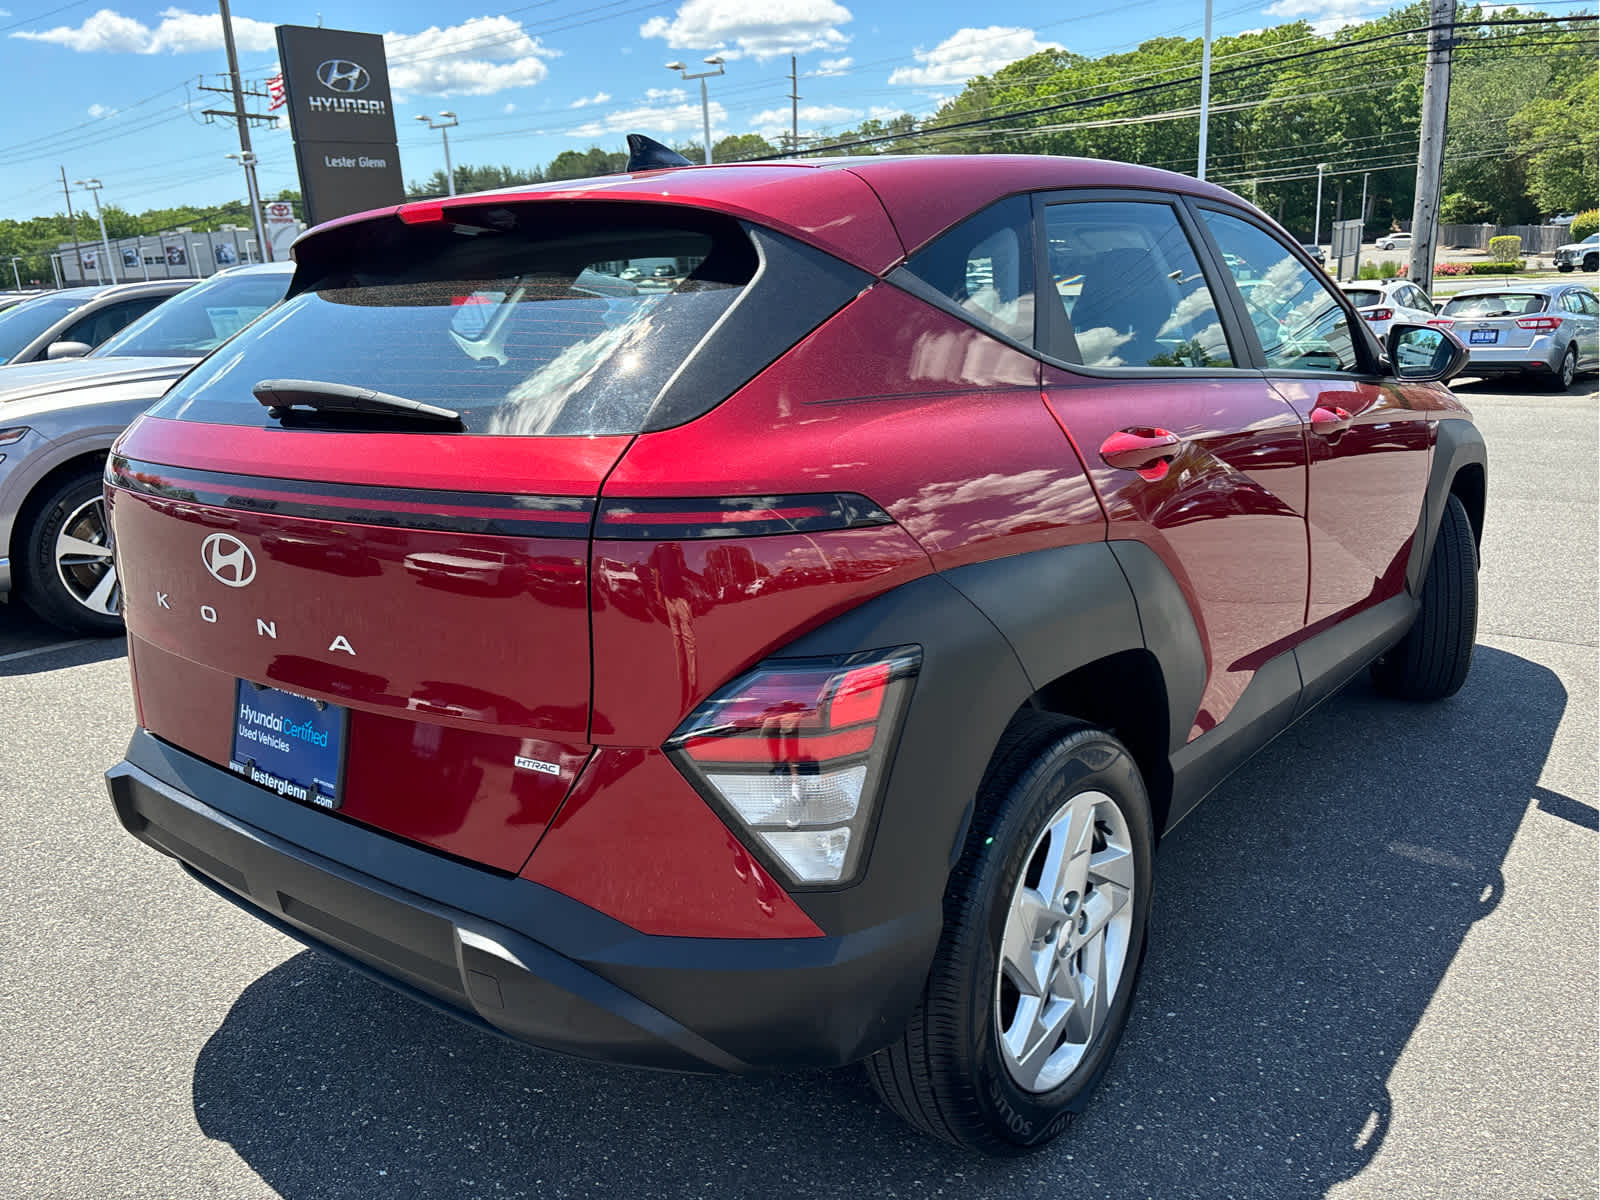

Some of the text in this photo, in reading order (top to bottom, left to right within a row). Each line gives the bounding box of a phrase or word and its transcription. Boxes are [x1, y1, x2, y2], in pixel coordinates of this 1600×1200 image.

[308, 96, 386, 115] HYUNDAI
[324, 155, 387, 168] Lester Glenn
[156, 591, 357, 656] KONA
[239, 724, 290, 753] Used Vehicles
[240, 703, 329, 748] Hyundai Certified
[516, 758, 556, 774] HTRAC
[250, 766, 307, 801] lesterglenn
[313, 794, 333, 809] .com
